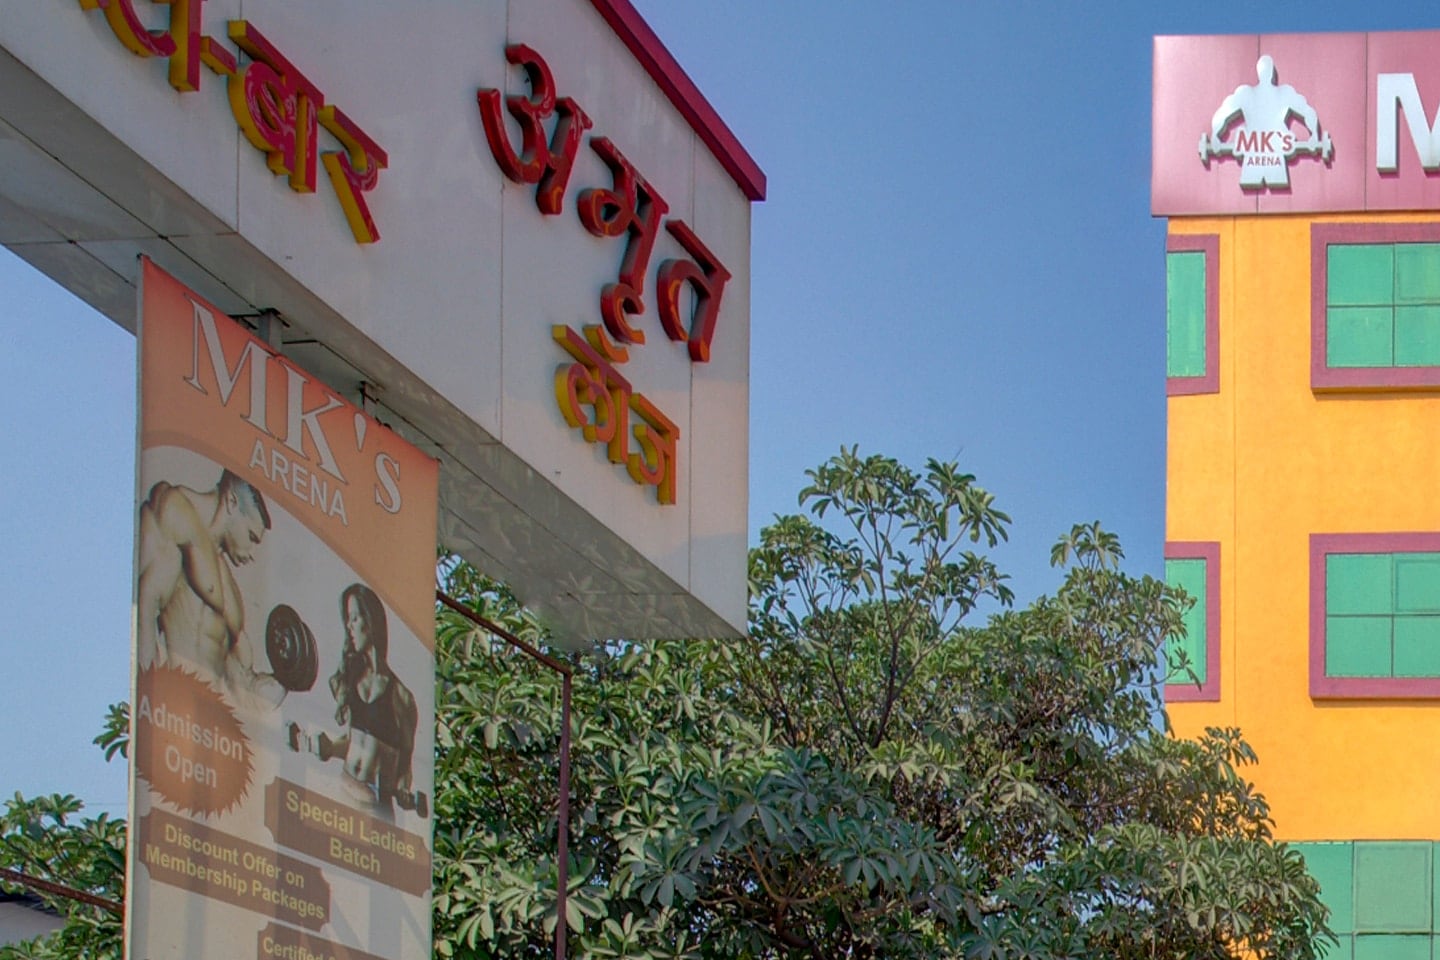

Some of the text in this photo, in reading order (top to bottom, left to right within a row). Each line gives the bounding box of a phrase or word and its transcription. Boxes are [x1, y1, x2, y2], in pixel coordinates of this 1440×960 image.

[1247, 156, 1282, 167] ARENA
[477, 43, 731, 362] अमृत
[551, 323, 680, 505] लॉज
[247, 438, 349, 527] ARENA
[137, 694, 244, 763] Admission
[164, 744, 218, 789] Open
[165, 823, 305, 889] Discount Offer on
[285, 789, 416, 861] Special Ladies
[329, 838, 382, 874] Batch
[145, 843, 325, 920] Membership Packages
